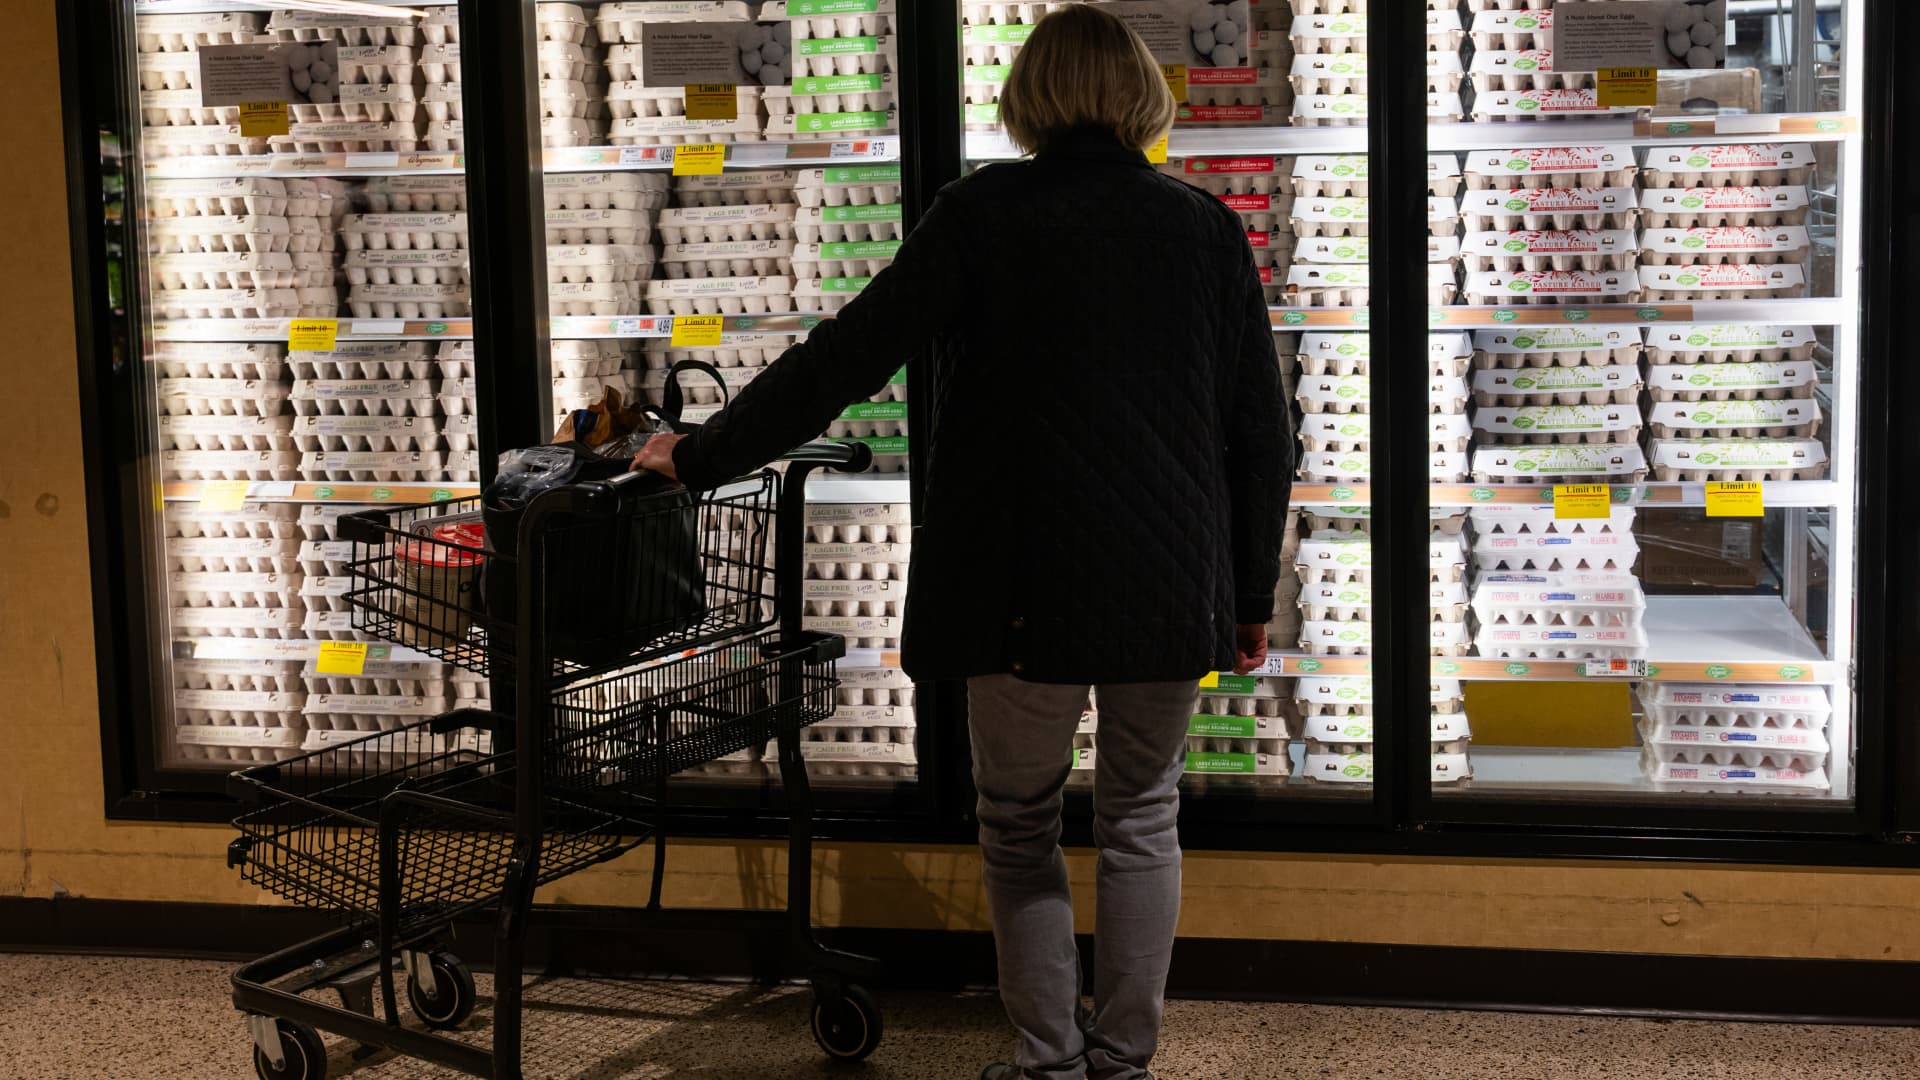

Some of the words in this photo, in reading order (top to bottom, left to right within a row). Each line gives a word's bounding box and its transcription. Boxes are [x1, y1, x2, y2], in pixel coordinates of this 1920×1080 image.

[1164, 66, 1174, 74] 10
[1611, 70, 1636, 78] Limit
[1639, 70, 1650, 78] 10
[699, 84, 720, 92] Limit
[724, 84, 732, 92] 10
[271, 102, 280, 110] 10
[706, 144, 715, 152] 10
[408, 154, 444, 166] Wegmans
[708, 318, 716, 326] 10
[320, 324, 328, 332] 10
[1566, 486, 1590, 494] Limit
[1720, 482, 1744, 490] Limit
[1747, 482, 1758, 490] 10
